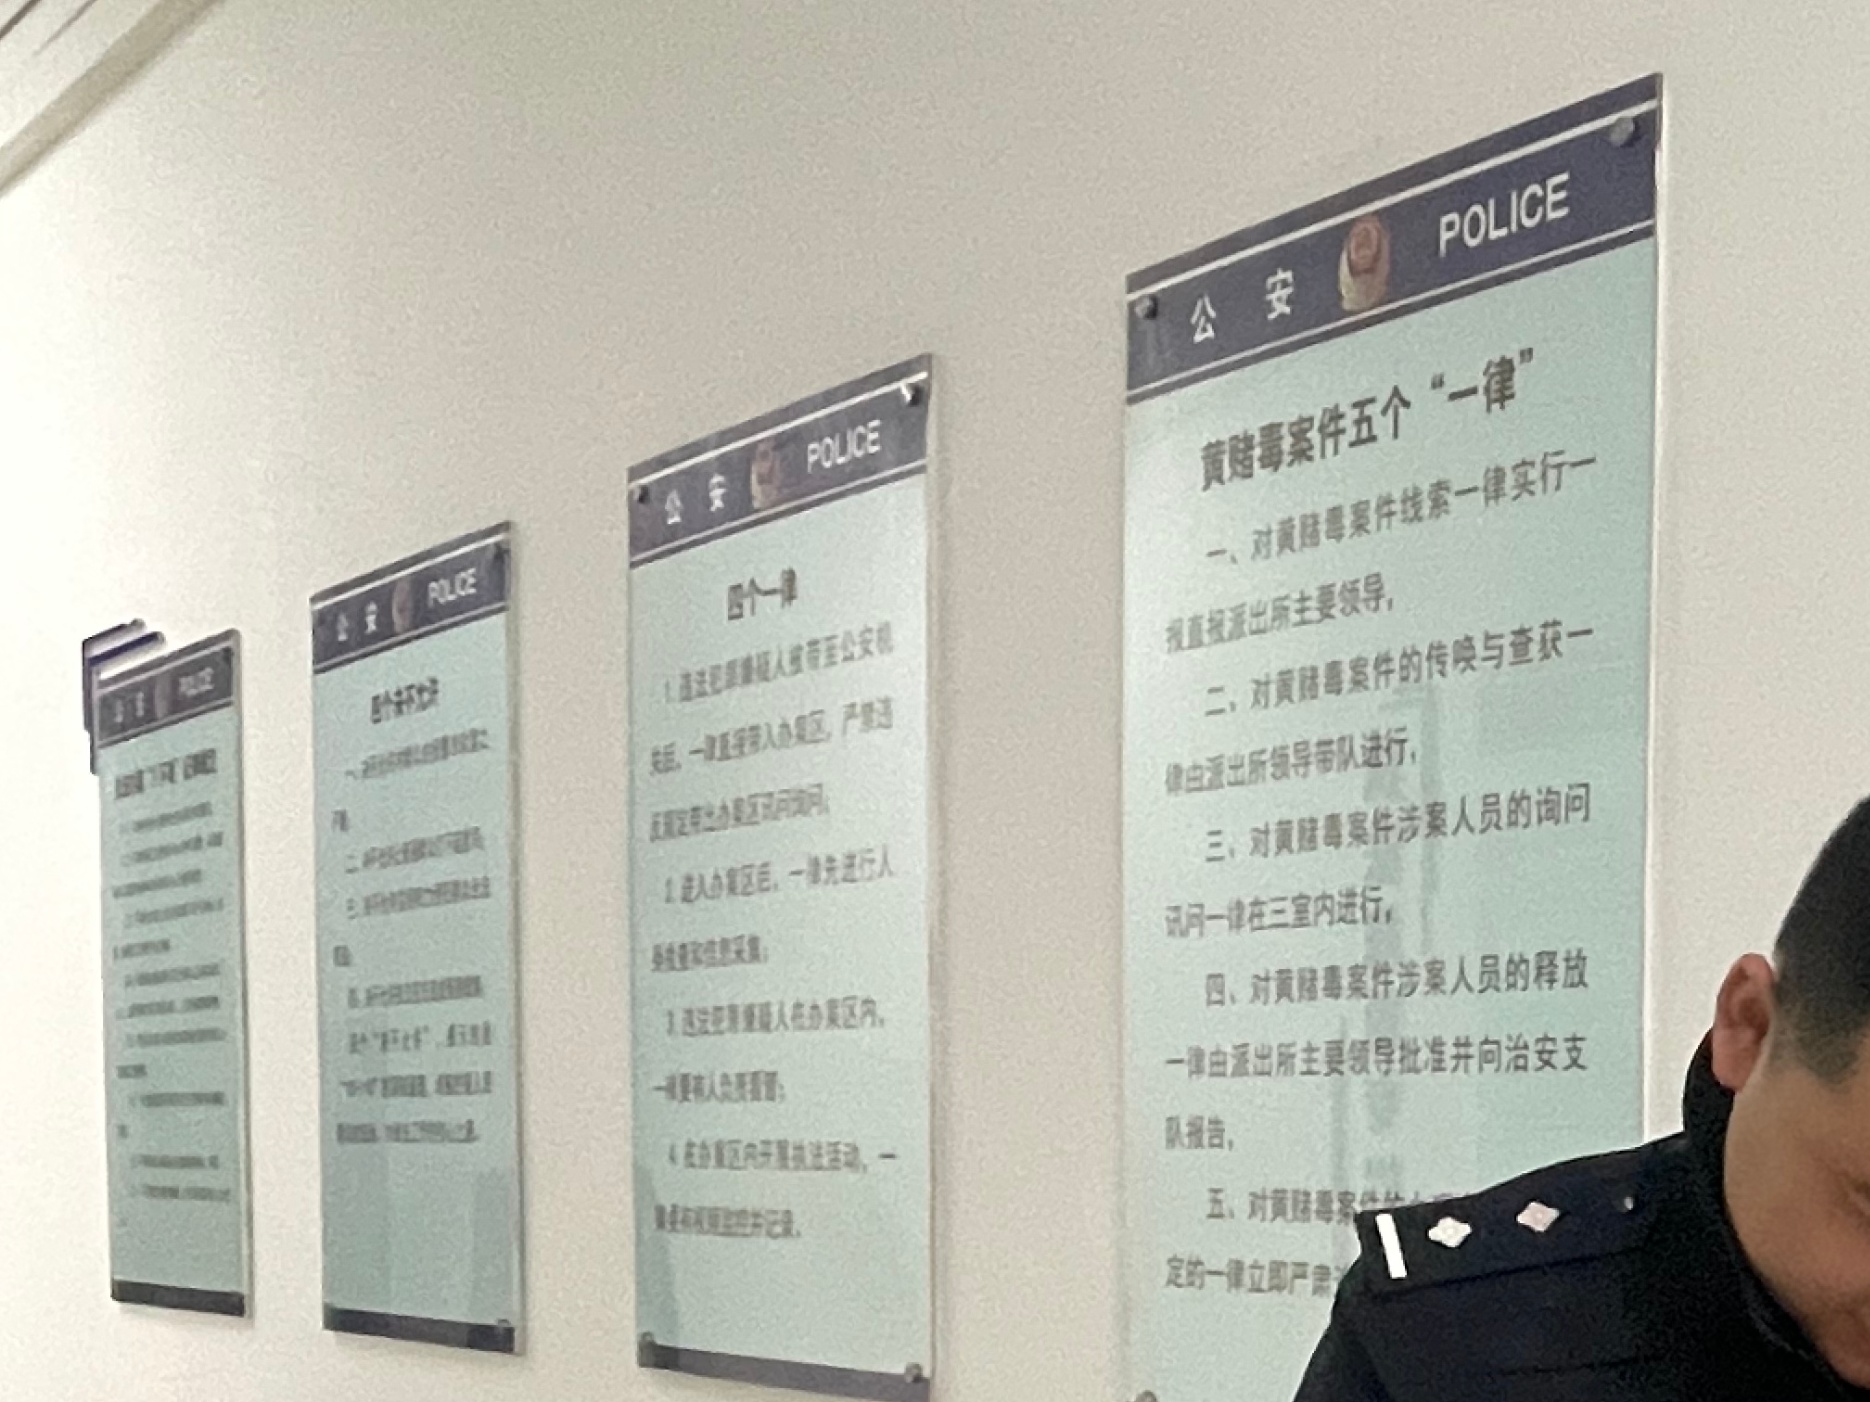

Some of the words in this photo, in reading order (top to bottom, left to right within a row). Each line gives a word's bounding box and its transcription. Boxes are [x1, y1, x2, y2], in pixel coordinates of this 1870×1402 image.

[1438, 172, 1571, 257] POLICE
[1190, 268, 1294, 344] 公安
[806, 418, 883, 474] POLICE
[1165, 1256, 1347, 1298] 定的一律立即严肃
